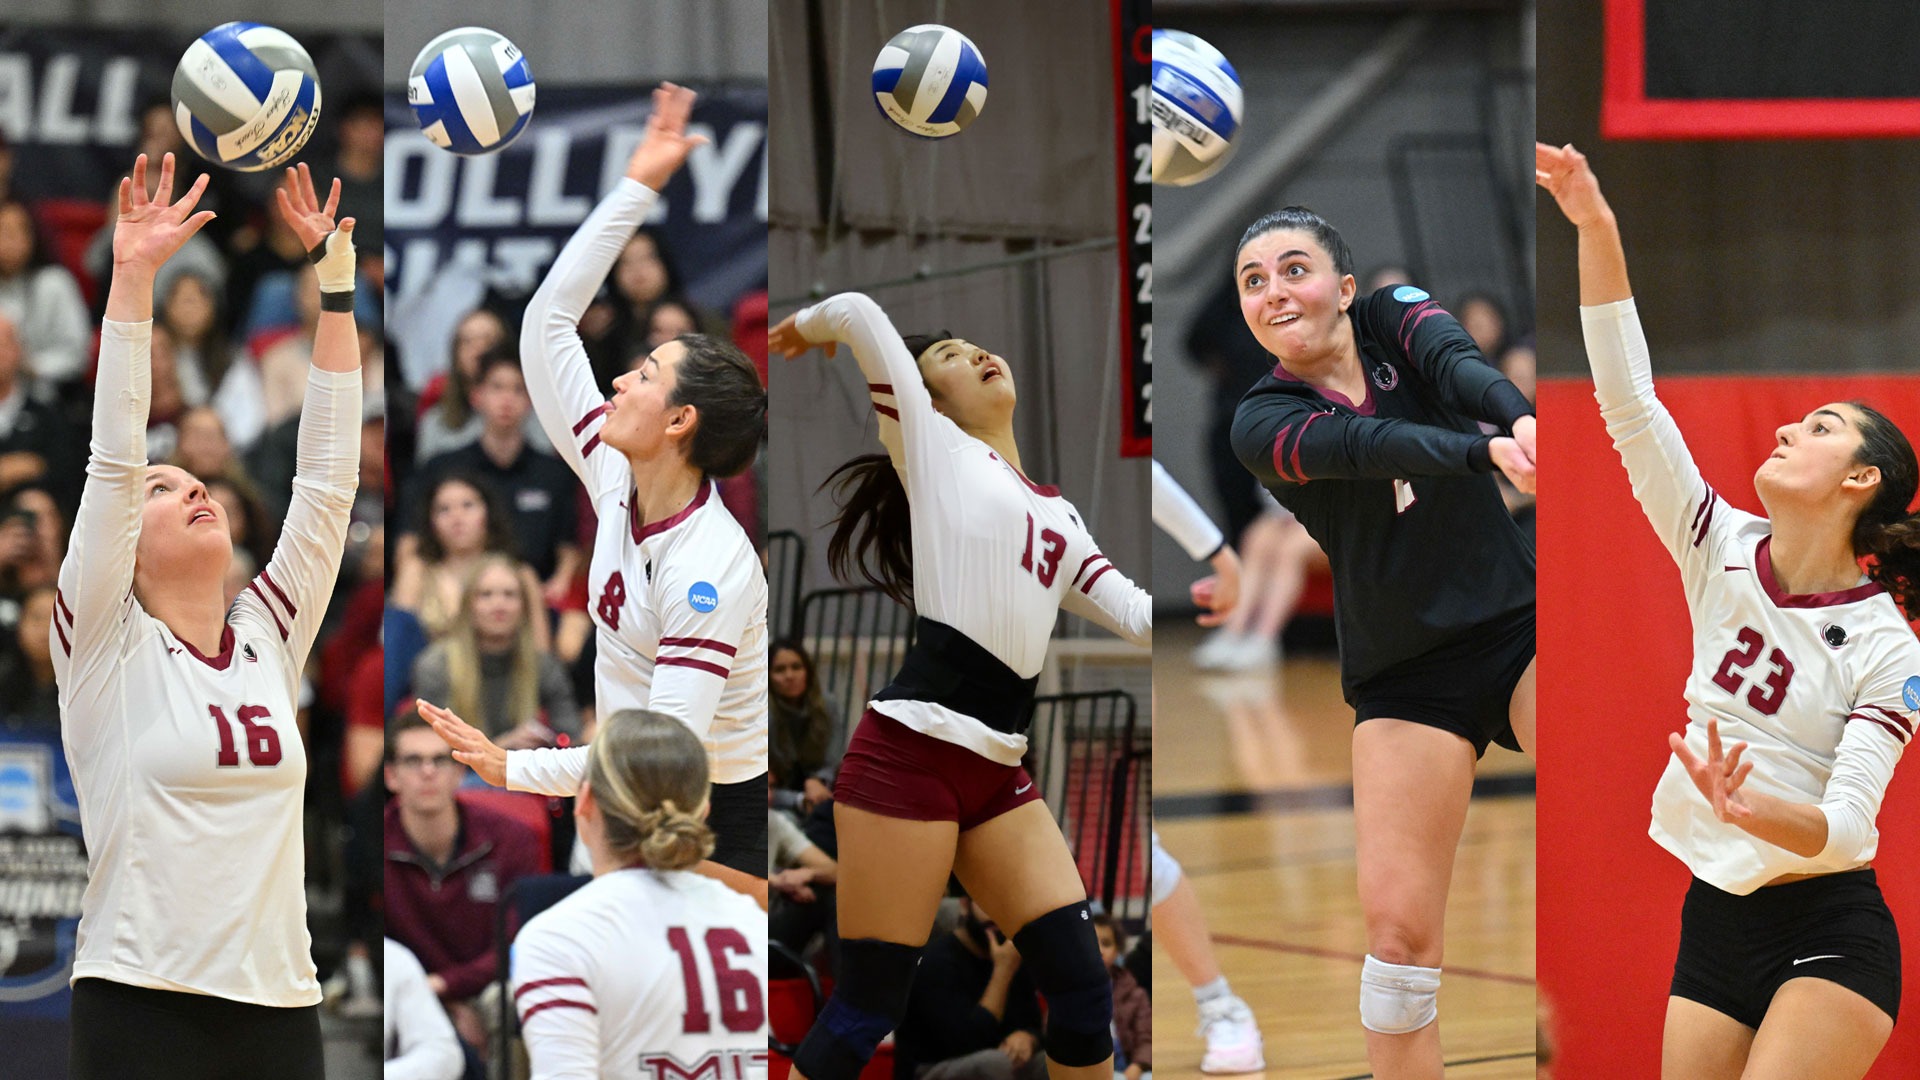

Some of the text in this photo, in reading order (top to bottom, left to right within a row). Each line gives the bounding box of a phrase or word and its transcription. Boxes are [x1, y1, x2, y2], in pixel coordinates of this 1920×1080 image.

[1020, 510, 1068, 590] 13
[597, 570, 627, 632] 8
[691, 593, 716, 608] NCAA
[1711, 624, 1796, 718] 23
[207, 703, 283, 769] 16
[667, 926, 766, 1034] 16
